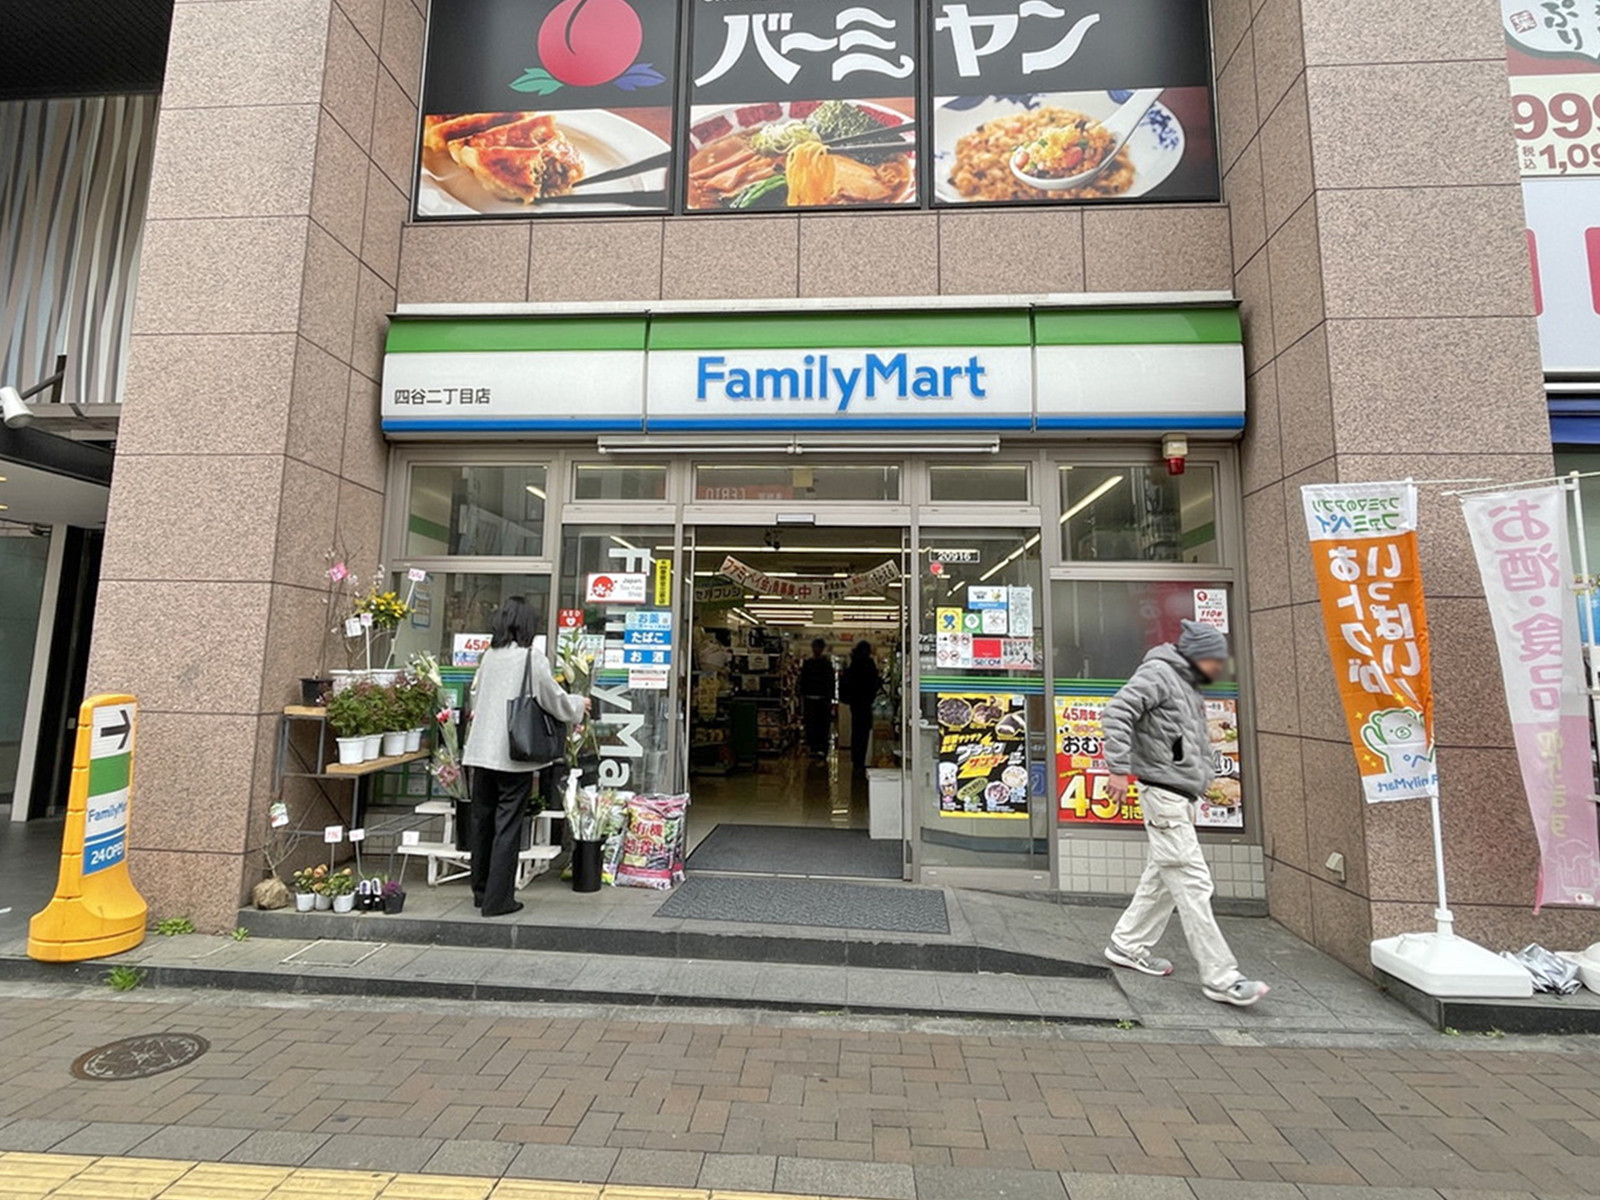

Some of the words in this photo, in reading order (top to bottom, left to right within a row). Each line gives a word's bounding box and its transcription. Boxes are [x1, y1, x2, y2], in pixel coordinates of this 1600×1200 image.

[694, 0, 1100, 87] バーミヤン
[1511, 93, 1600, 140] 99
[394, 388, 491, 406] 四谷二丁目店
[698, 353, 986, 411] FamilyMart
[562, 610, 581, 618] AED
[631, 632, 664, 644] たばこ
[1063, 736, 1105, 754] おむ
[1060, 775, 1121, 819] 45
